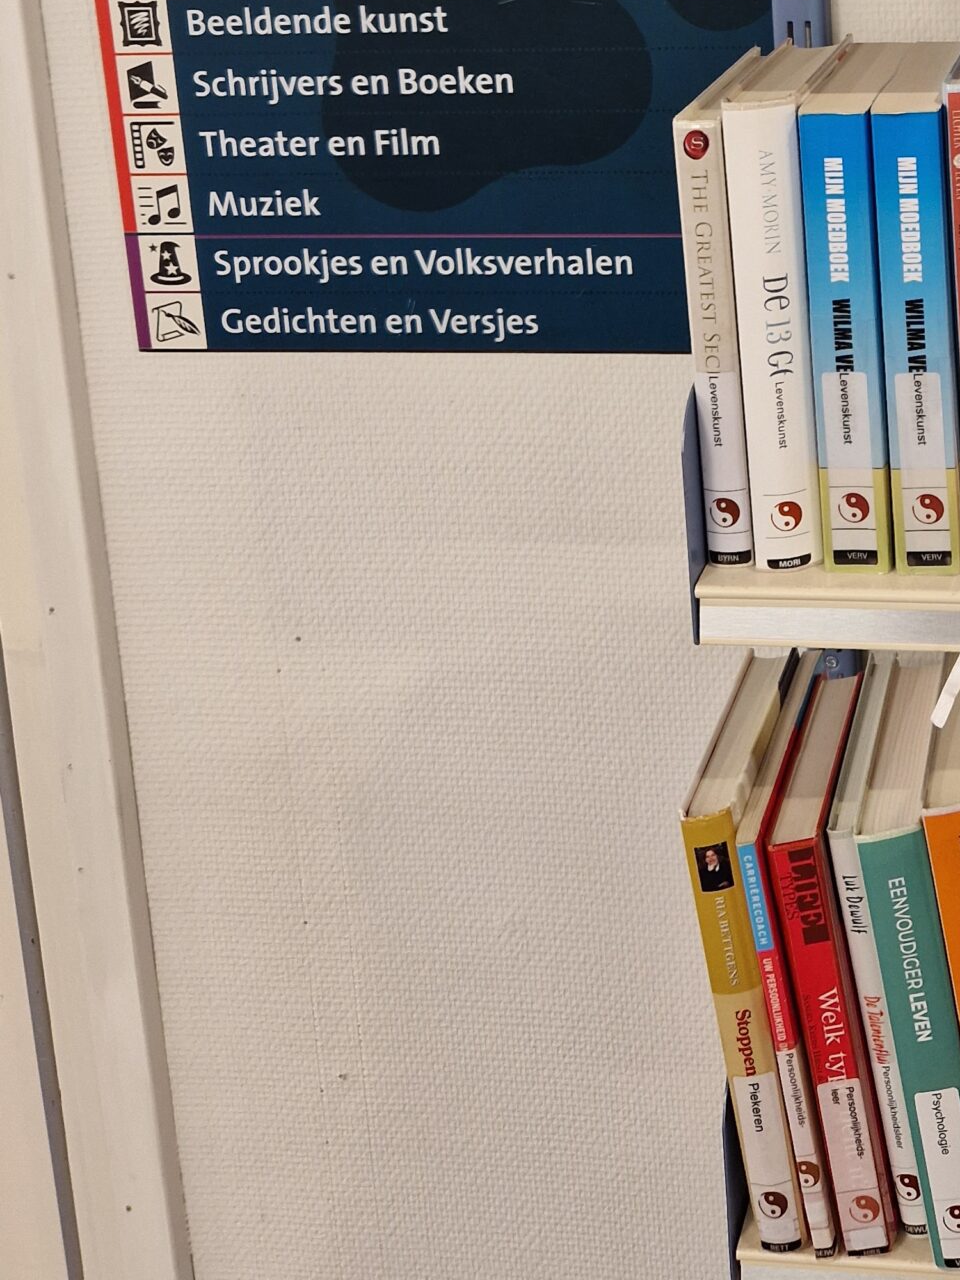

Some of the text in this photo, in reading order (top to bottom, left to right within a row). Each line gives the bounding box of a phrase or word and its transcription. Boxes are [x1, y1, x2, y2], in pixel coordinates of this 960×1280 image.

[187, 5, 448, 35] Beeldende kunst
[193, 66, 513, 104] Schrijvers en Boeken
[199, 128, 439, 156] Theater en Film
[209, 189, 320, 216] Muziek
[214, 248, 632, 283] Sprookjes en Volksverhalen
[823, 157, 855, 351] MIJN MOEDBOEK WILMA
[222, 307, 538, 342] Gedichten en Versjes
[775, 381, 787, 449] Levenskunst
[888, 877, 933, 1043] EENVOUDIGER LEVEN
[748, 1082, 764, 1133] Piekeren
[931, 1092, 949, 1156] Psychologie
